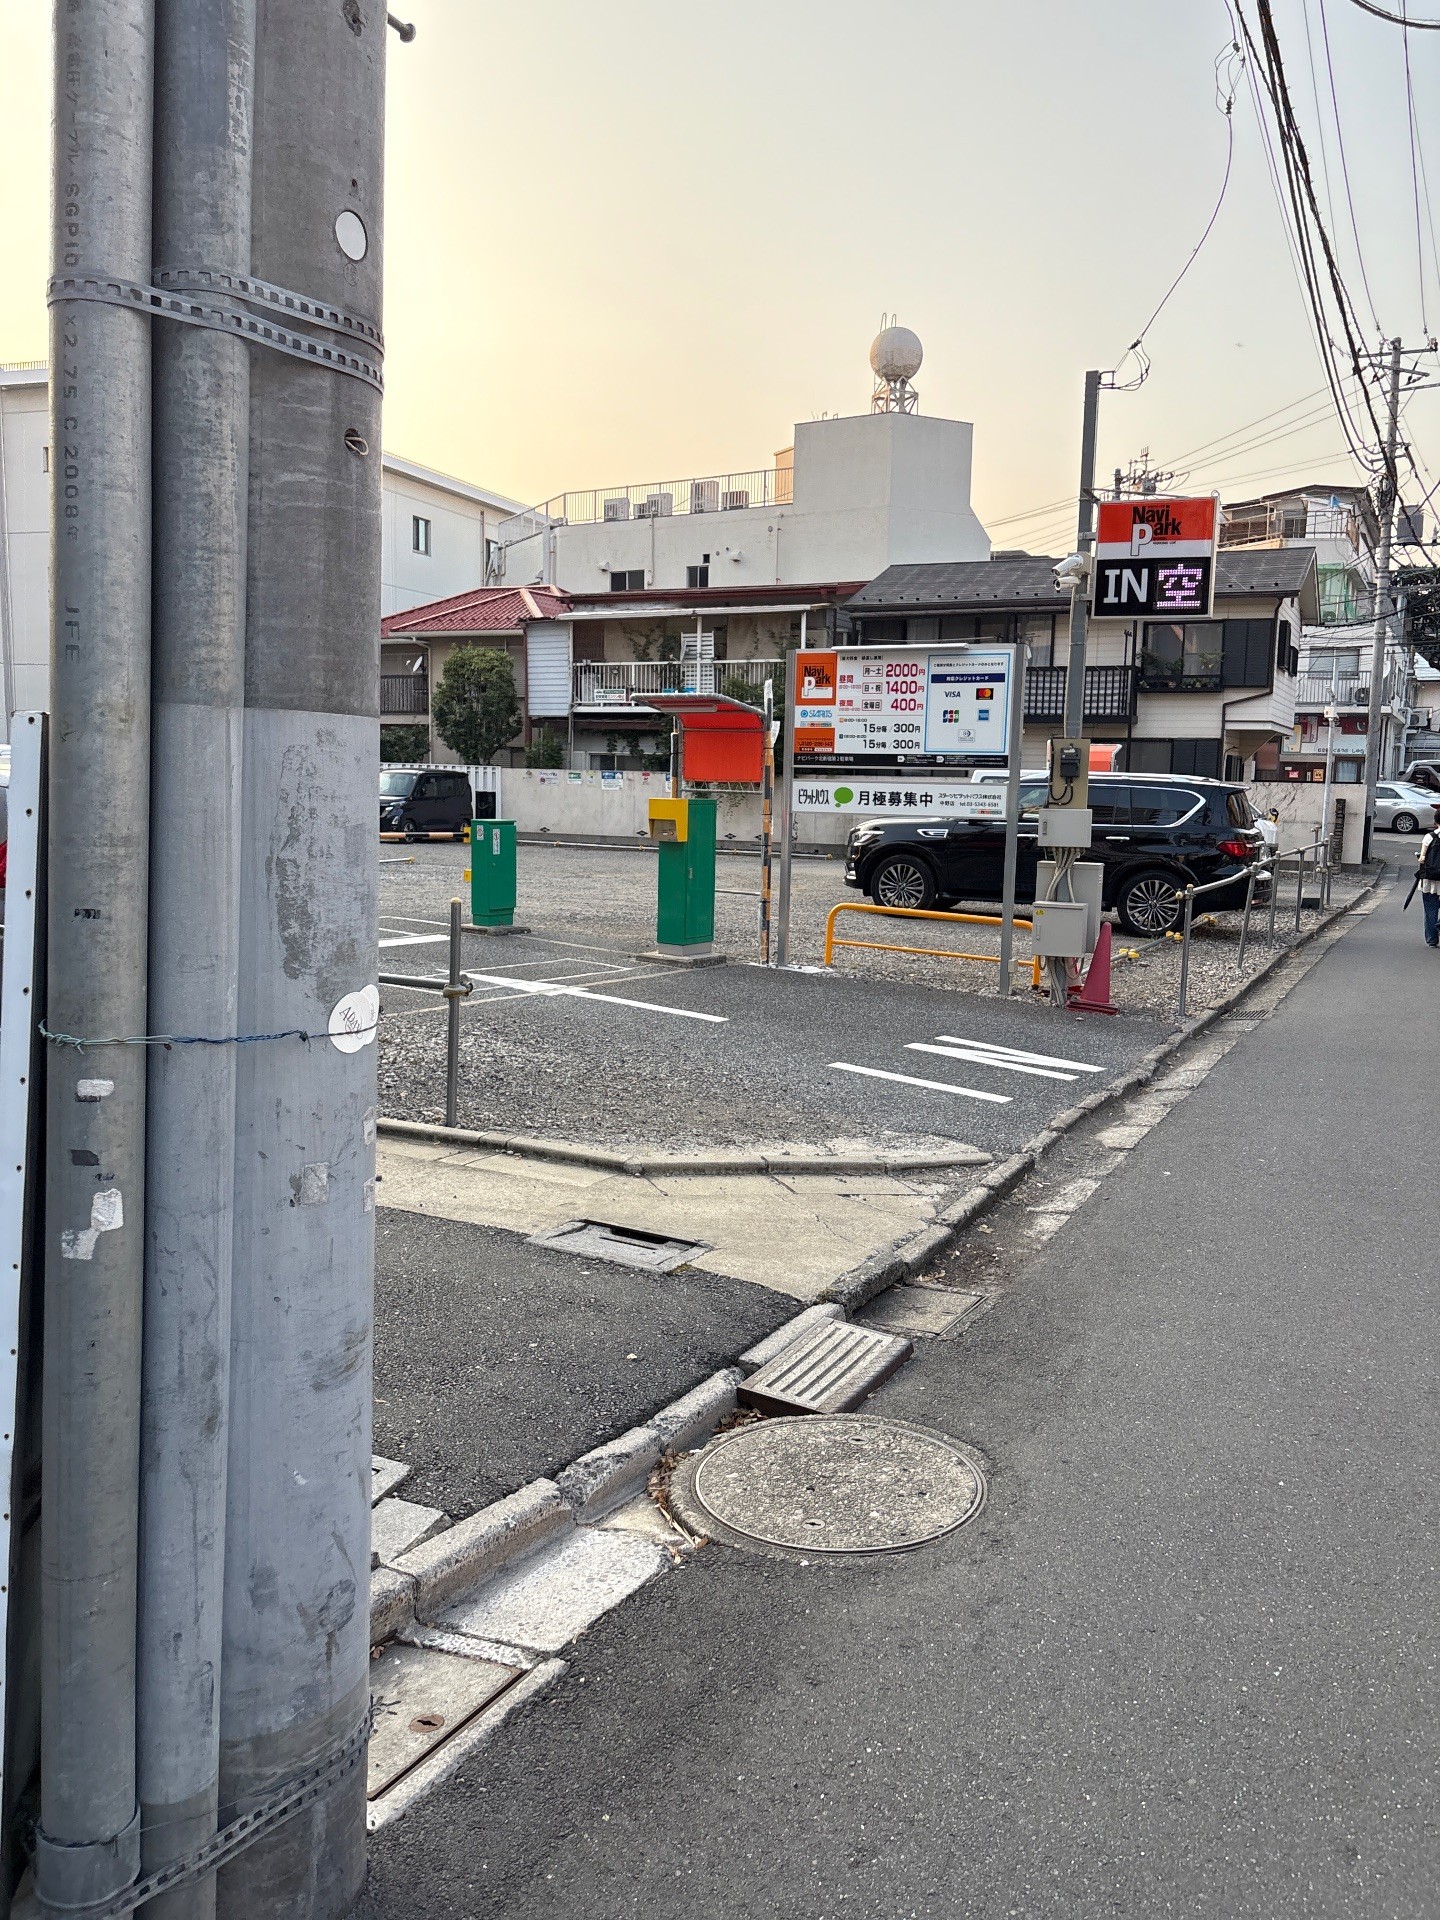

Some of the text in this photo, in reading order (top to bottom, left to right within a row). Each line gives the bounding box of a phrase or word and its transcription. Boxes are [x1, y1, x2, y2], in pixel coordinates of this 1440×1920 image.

[1132, 504, 1170, 524] Navi
[1130, 517, 1182, 556] Park
[1103, 568, 1149, 604] IN
[1156, 563, 1203, 610] 空
[803, 665, 825, 677] Navi
[885, 663, 926, 677] 2000円
[839, 675, 854, 684] 昼間
[885, 680, 925, 695] 1400円
[944, 690, 961, 698] VISA
[839, 699, 854, 707] 夜間
[890, 698, 924, 711] 400円
[943, 711, 959, 721] JCB
[858, 791, 933, 807] 月極募集中
